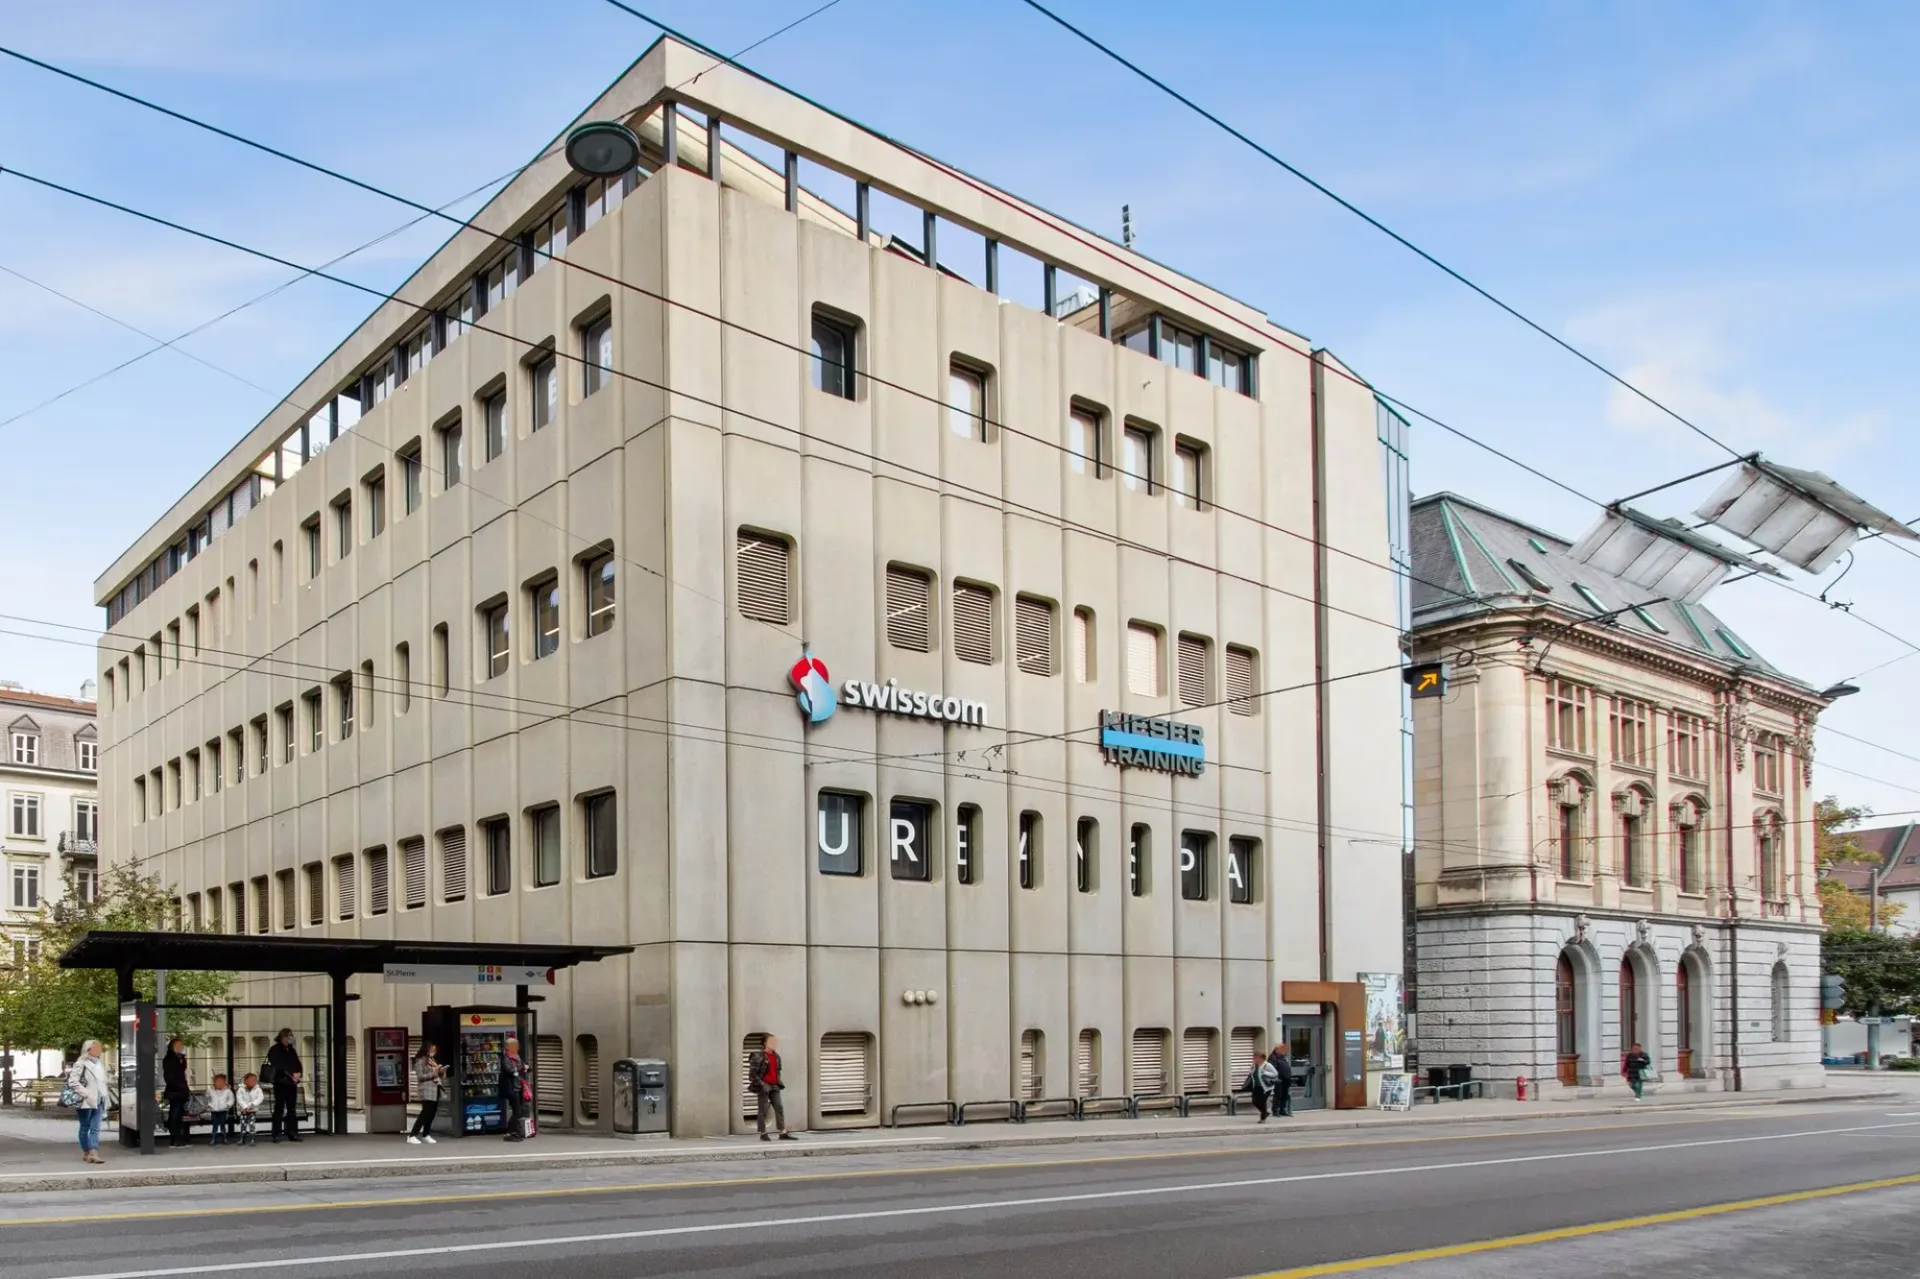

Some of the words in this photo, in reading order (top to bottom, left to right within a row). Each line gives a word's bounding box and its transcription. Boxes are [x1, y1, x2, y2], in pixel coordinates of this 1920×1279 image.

[844, 677, 988, 726] swisscom
[1102, 708, 1204, 747] KIESER
[1103, 744, 1205, 775] TRAINING
